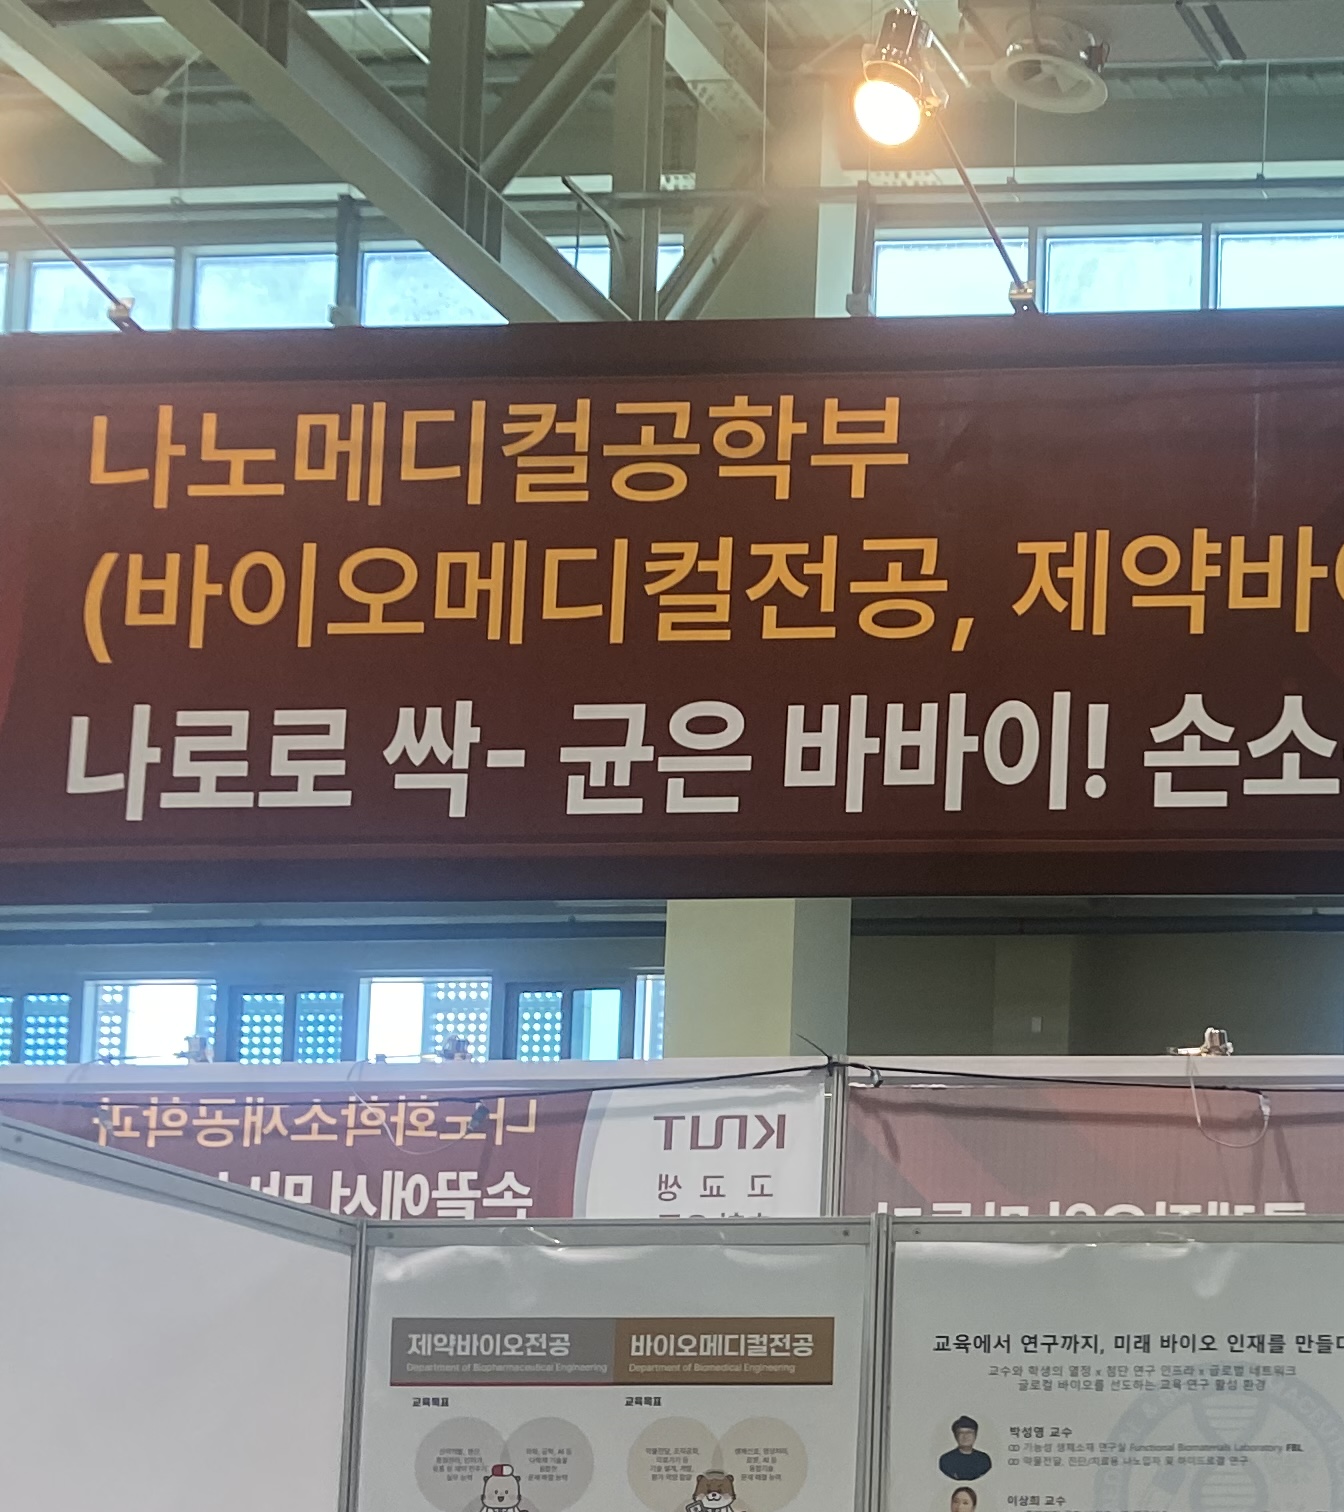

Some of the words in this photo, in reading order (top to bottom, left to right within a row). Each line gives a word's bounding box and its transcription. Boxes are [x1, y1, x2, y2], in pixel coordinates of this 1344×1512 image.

[90, 396, 910, 509] 나노메디컬공학부
[84, 535, 975, 664] (바이오메디컬전공,
[67, 704, 352, 821] 나로로
[384, 700, 525, 818] 싹-
[560, 700, 752, 816] 균은
[784, 691, 1109, 814] 바바이!
[407, 1333, 571, 1357] 제약바이오전공
[630, 1333, 814, 1357] 바이오메디컬전공
[932, 1333, 1011, 1354] 교육에서
[1114, 1333, 1151, 1354] 미래
[1159, 1333, 1218, 1354] 바이오
[1226, 1333, 1286, 1354] 인재를
[1049, 1426, 1073, 1439] 교수
[1044, 1495, 1066, 1507] 교수
